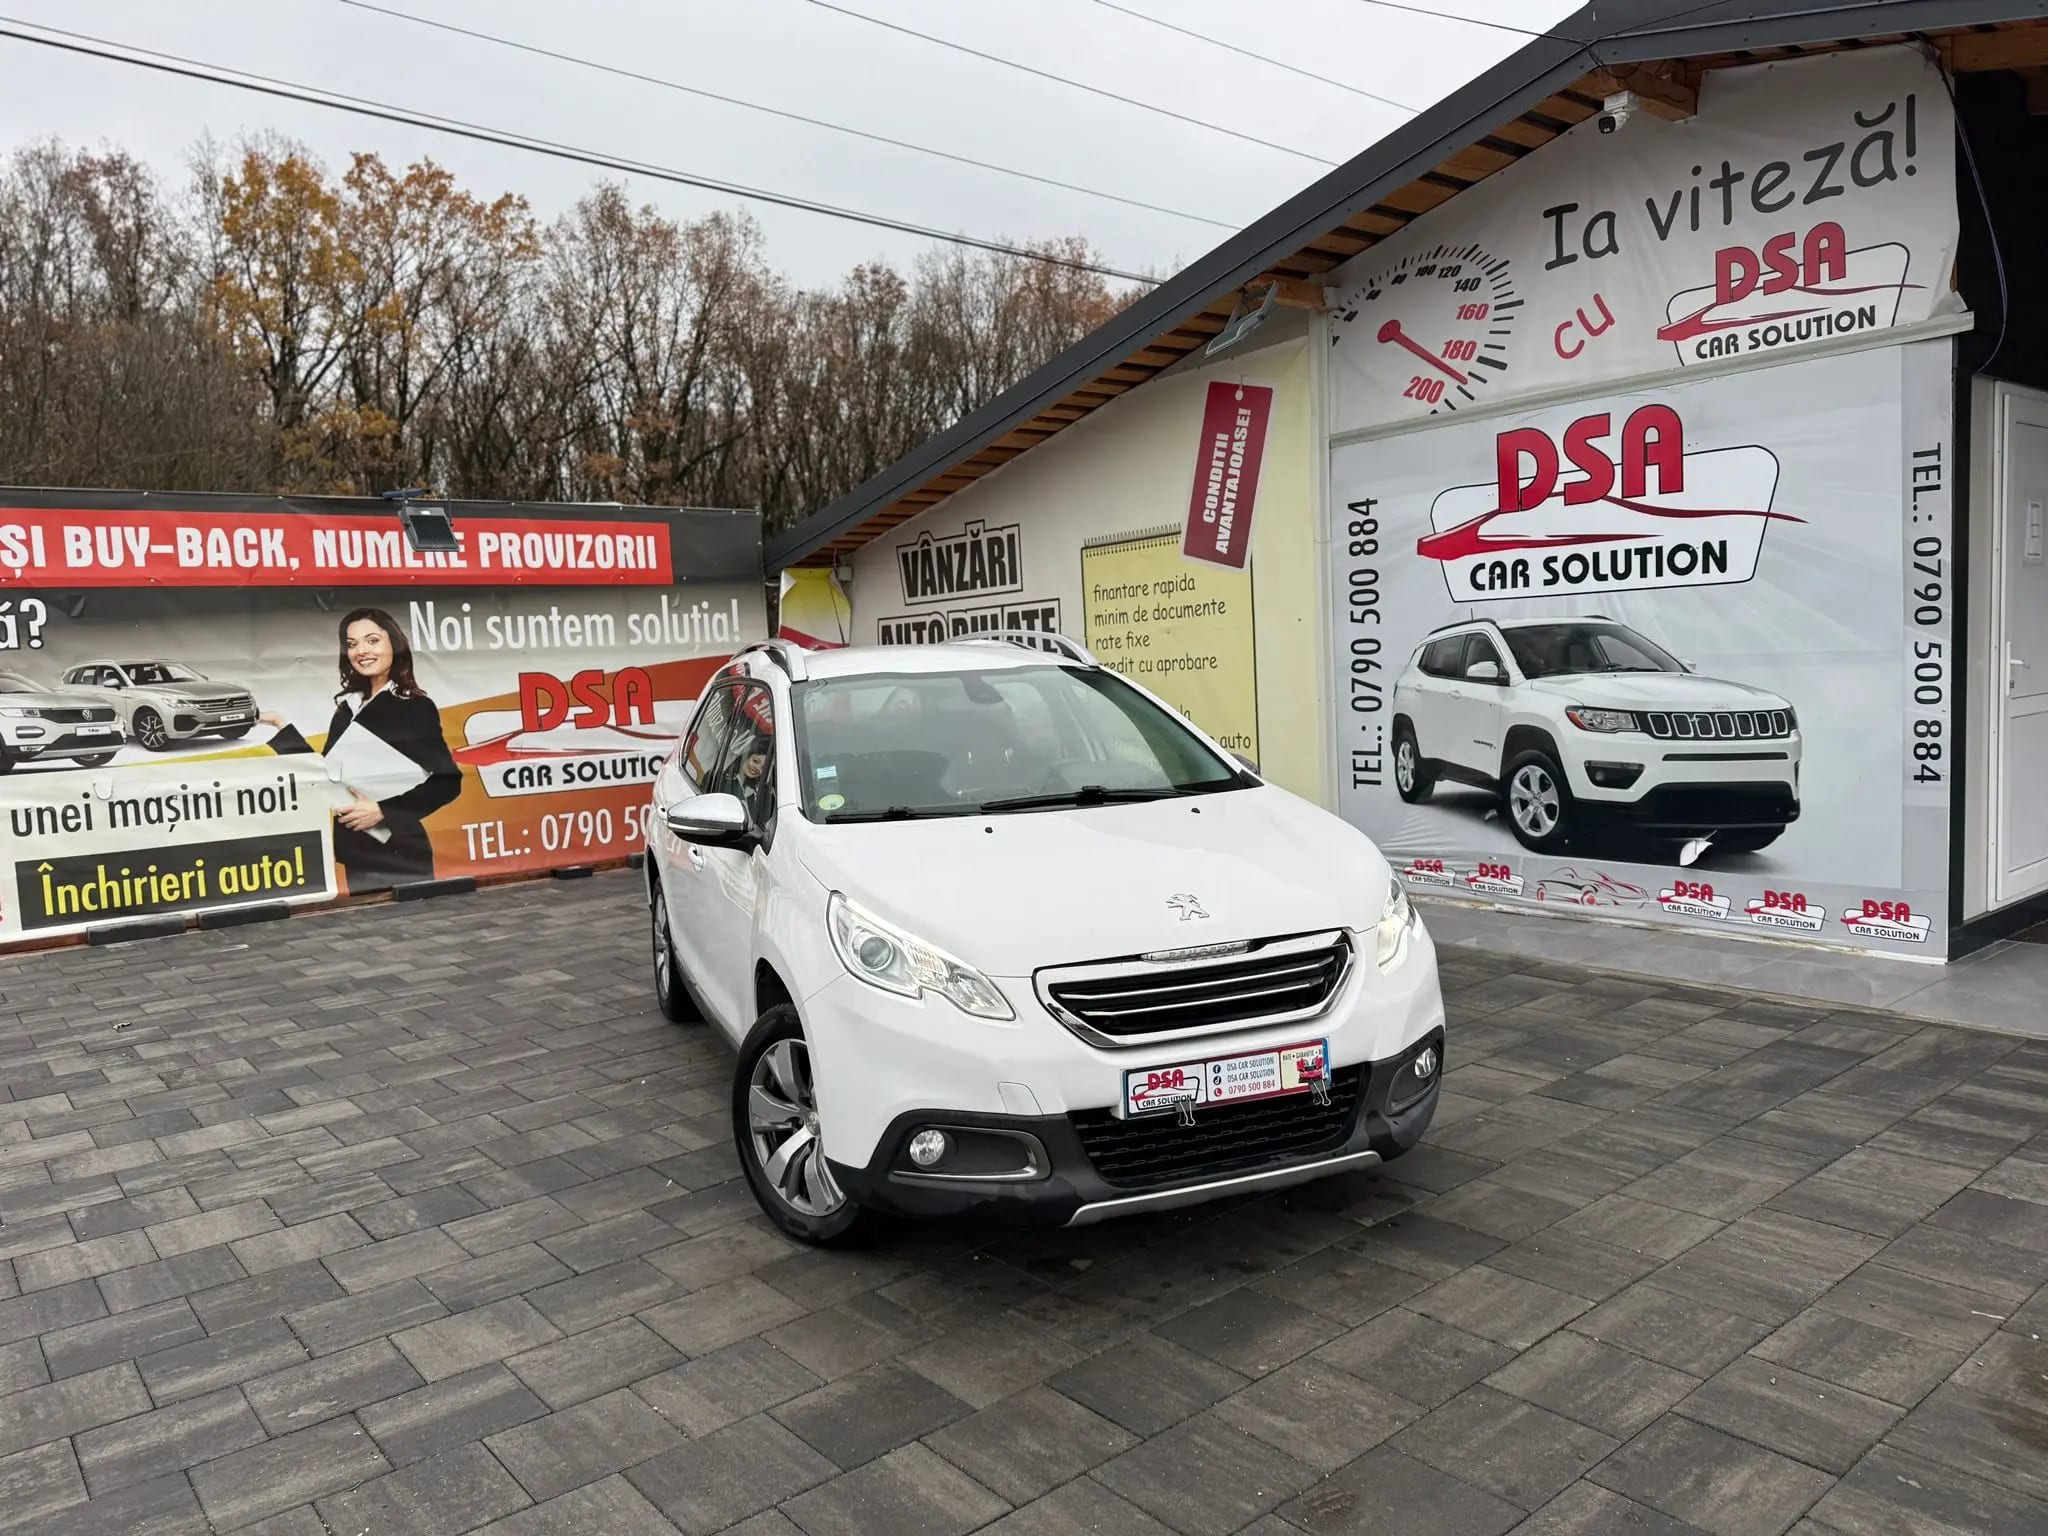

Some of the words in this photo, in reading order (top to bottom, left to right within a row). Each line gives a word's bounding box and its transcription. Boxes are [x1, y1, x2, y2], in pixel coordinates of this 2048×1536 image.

[1543, 202, 1619, 270] Ia
[1646, 94, 1917, 241] viteză!
[1414, 264, 1437, 278] 100
[1437, 264, 1461, 279] 120
[1715, 221, 1846, 305] DSA
[1453, 277, 1481, 293] 140
[1456, 303, 1489, 320] 160
[1554, 293, 1615, 359] cu
[1695, 333, 1739, 360] CAR
[1748, 304, 1876, 351] SOLUTION
[1441, 340, 1477, 361] 180
[1403, 376, 1445, 404] 200
[1497, 403, 1683, 513] DSA
[1215, 407, 1251, 554] AVANTAJOASE!
[1912, 442, 1941, 523] TEL.:
[1347, 497, 1379, 556] 884
[0, 524, 46, 578] ȘI
[63, 525, 300, 571] BUY-BACK,
[477, 532, 657, 570] PROVIZORII
[901, 527, 1019, 599] VÂNZĂRI
[1469, 559, 1530, 591] CAR
[1543, 540, 1728, 586] SOLUTION
[1093, 584, 1149, 602] finantare
[1153, 573, 1195, 599] rapida
[1913, 536, 1942, 625] 0790
[1349, 568, 1381, 624] 500
[409, 600, 475, 651] Noi
[486, 606, 616, 648] suntem
[628, 594, 742, 653] soluția!
[1094, 608, 1129, 627] minim
[1132, 605, 1148, 623] de
[1152, 598, 1227, 622] documente
[1096, 634, 1121, 651] rate
[1126, 630, 1151, 649] fixe
[1138, 658, 1152, 672] cu
[1156, 652, 1218, 677] aprobare
[1350, 637, 1383, 712] 0790
[1914, 641, 1942, 705] 500
[518, 666, 655, 733] DSA
[1219, 732, 1251, 749] auto
[1913, 719, 1942, 783] 884
[1351, 723, 1383, 789] TEL.:
[502, 765, 552, 789] CAR
[11, 792, 94, 838] unei
[108, 779, 223, 833] mașini
[237, 773, 299, 818] noi!
[461, 816, 531, 861] TEL.:
[541, 808, 613, 851] 0790
[37, 862, 206, 916] Închirieri
[218, 846, 305, 894] auto!
[1478, 862, 1511, 881] DSA
[1674, 880, 1714, 902] DSA
[1764, 890, 1807, 912] DSA
[1667, 904, 1682, 913] CAR
[1683, 906, 1722, 918] SOLUTION
[1757, 914, 1772, 924] CAR
[1774, 917, 1816, 930] SOLUTION
[1862, 900, 1911, 922] DSA
[1855, 926, 1872, 936] CAR
[1875, 929, 1920, 941] SOLUTION
[1226, 1063, 1238, 1072] DSA
[1237, 1061, 1249, 1070] CAR
[1249, 1056, 1275, 1068] SOLUTION
[1227, 1074, 1239, 1083] DSA
[1238, 1072, 1250, 1082] CAR
[1249, 1067, 1275, 1079] SOLUTION
[1147, 1068, 1185, 1090] DSA
[1229, 1084, 1246, 1095] 0790
[1248, 1081, 1261, 1092] 500
[1262, 1079, 1276, 1090] 884
[1142, 1097, 1156, 1108] CAR
[1157, 1093, 1192, 1105] SOLUTION
